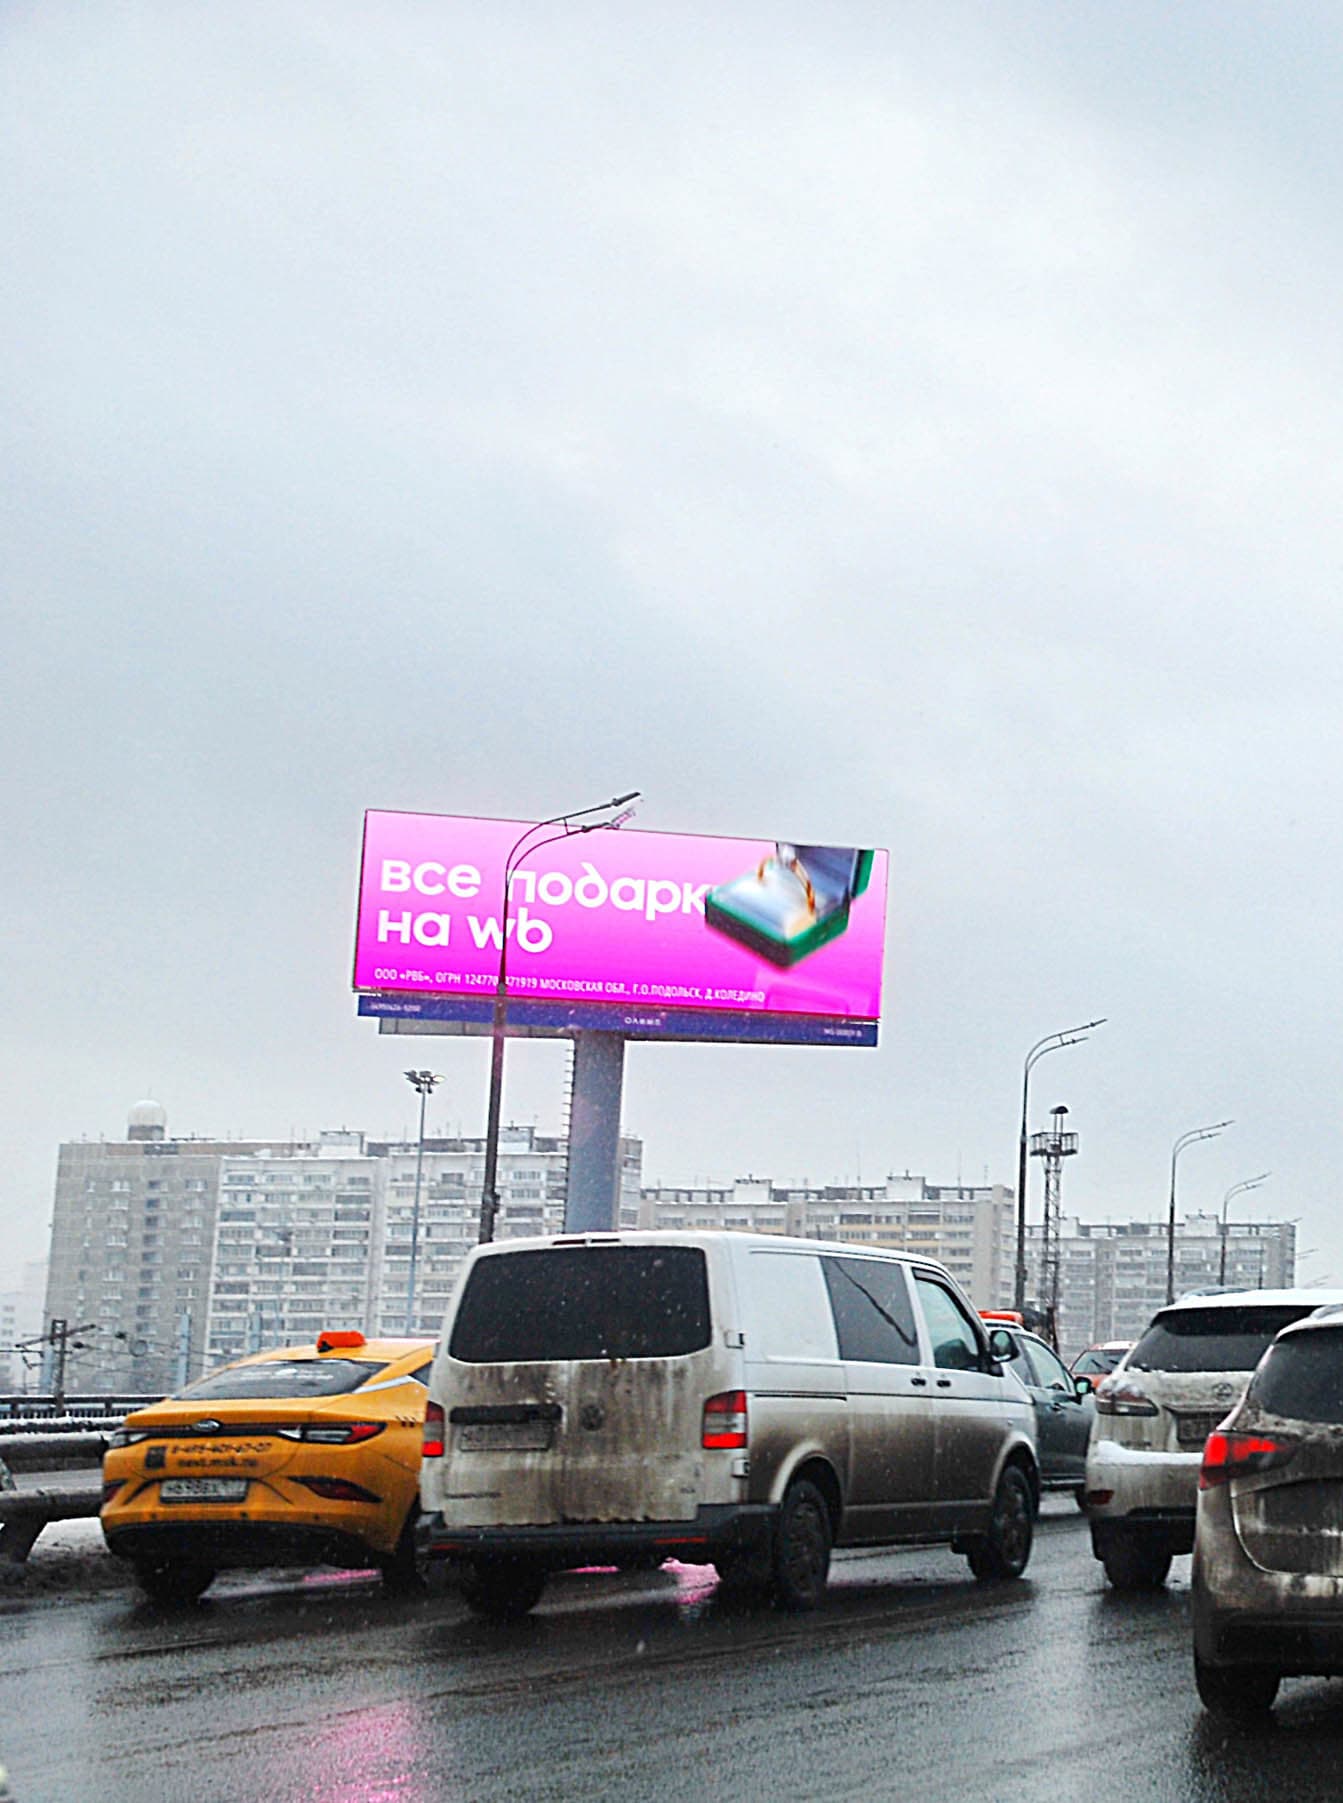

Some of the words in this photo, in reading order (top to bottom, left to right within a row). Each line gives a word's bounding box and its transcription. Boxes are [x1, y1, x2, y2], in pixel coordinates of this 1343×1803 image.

[380, 859, 482, 898] все
[506, 862, 712, 921] подарк
[376, 909, 451, 946] на
[466, 906, 553, 953] wb
[374, 968, 397, 979] ООО
[435, 971, 461, 984] ОГРН
[540, 977, 603, 992] МОСКОВСКАЯ
